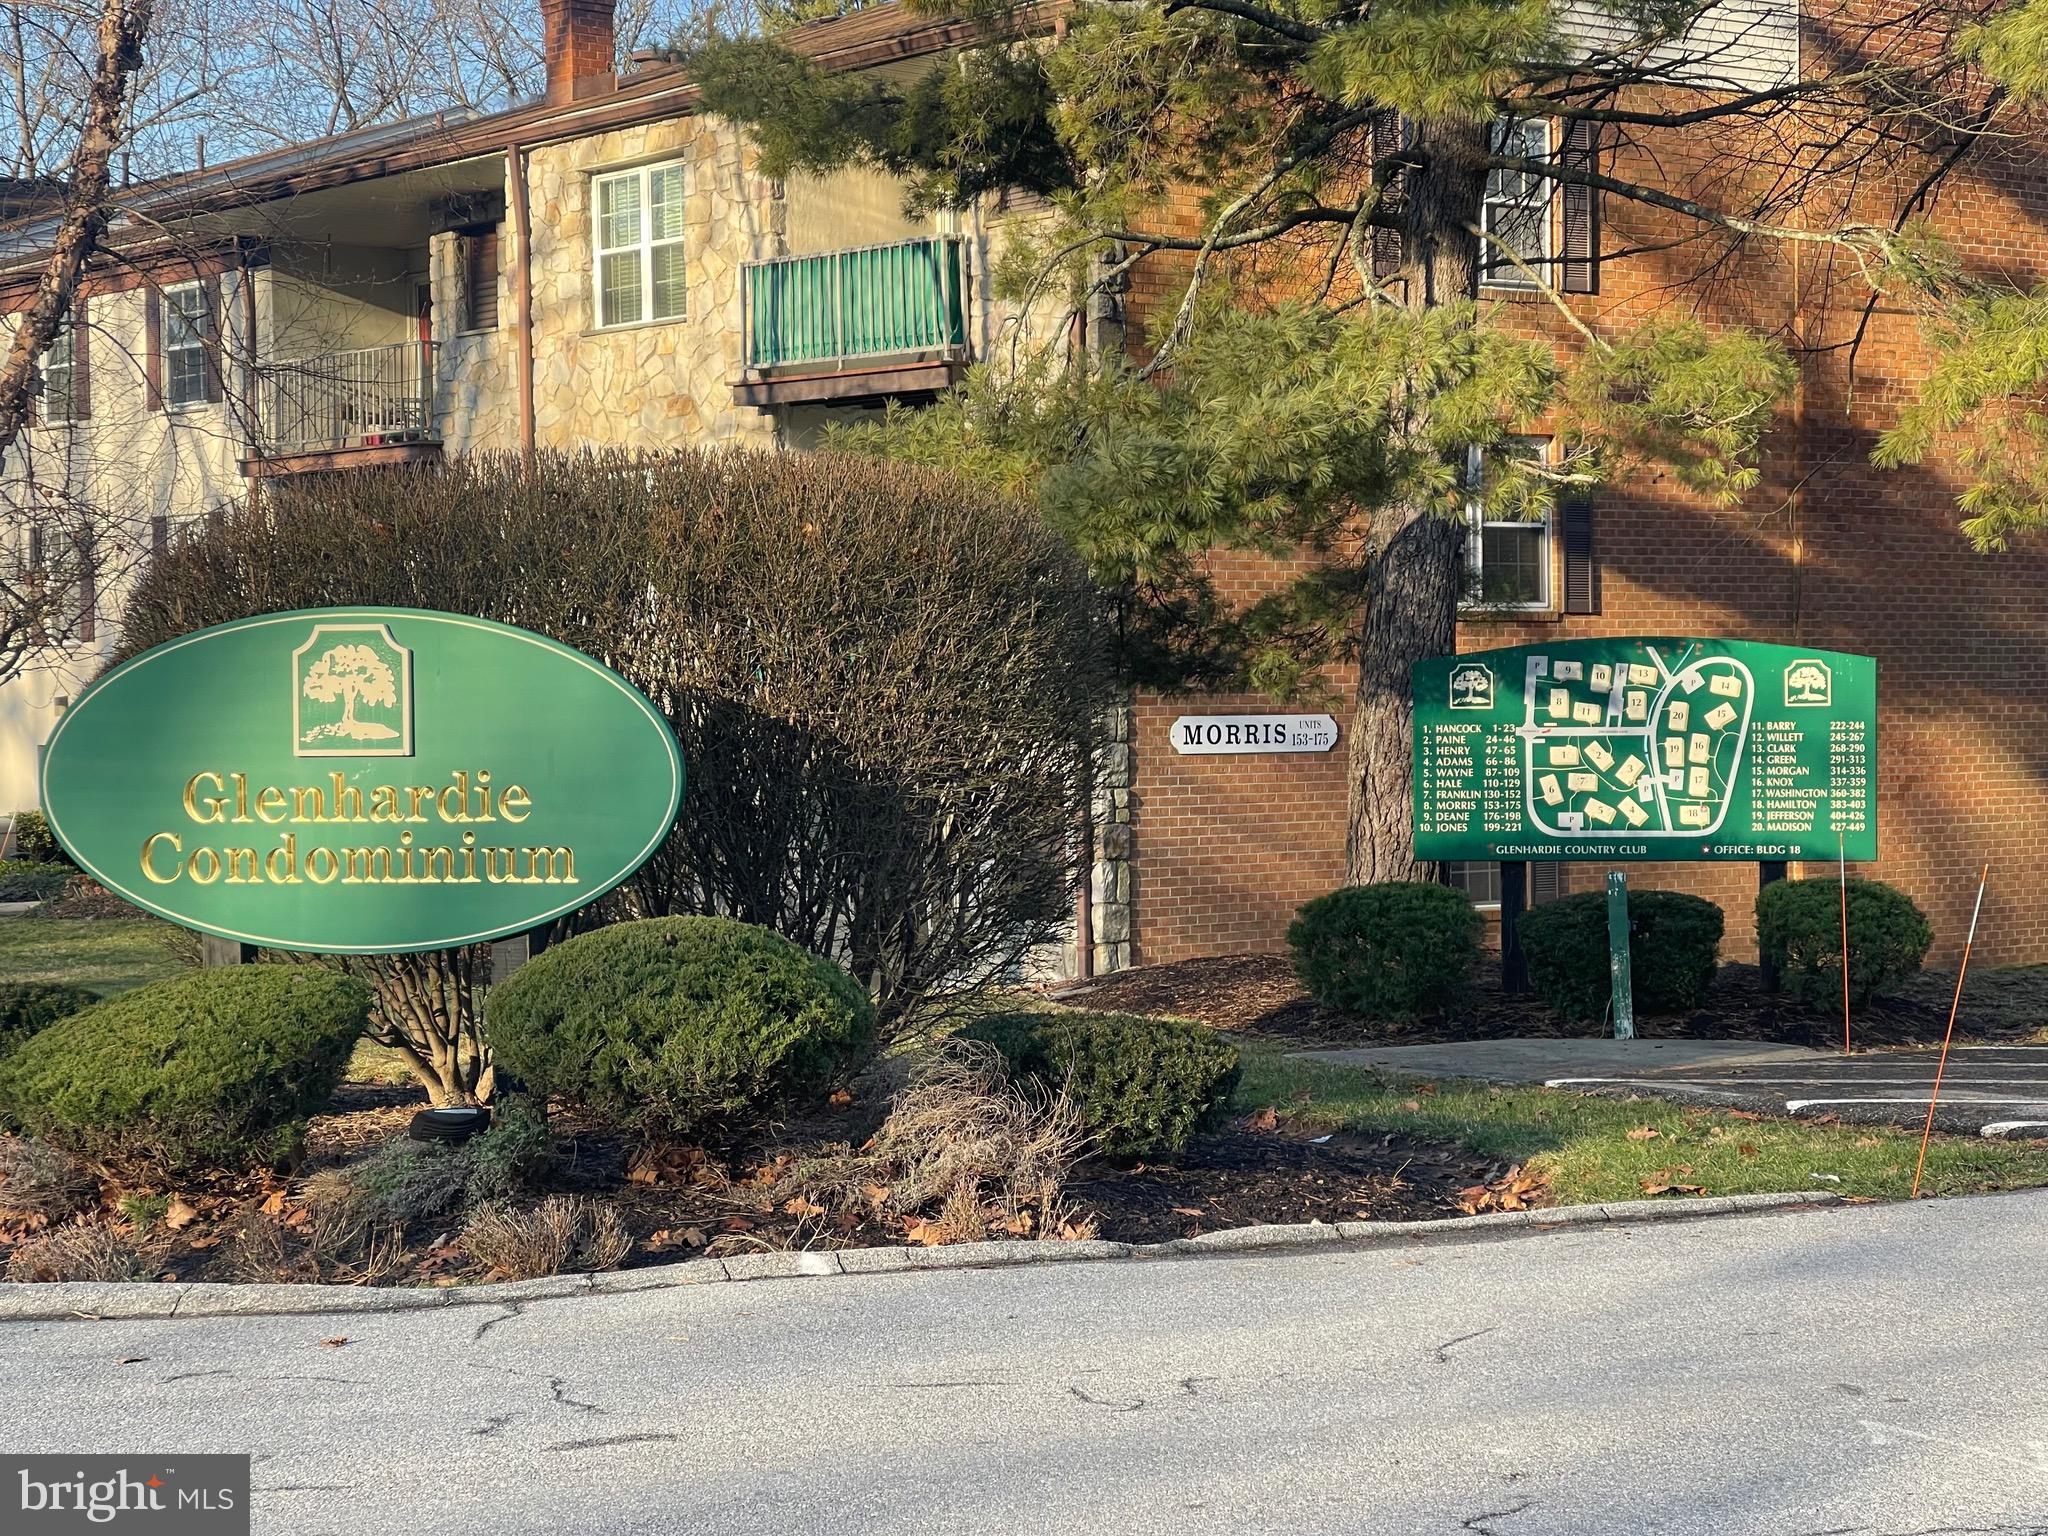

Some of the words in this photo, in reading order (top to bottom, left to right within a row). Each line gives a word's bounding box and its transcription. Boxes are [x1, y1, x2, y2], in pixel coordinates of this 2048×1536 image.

[1565, 665, 1571, 674] 9
[1595, 672, 1606, 680] 10
[1721, 682, 1730, 690] 14
[1672, 711, 1684, 720] 20
[1717, 710, 1726, 718] 15
[1299, 720, 1322, 729] UNITS
[1423, 725, 1432, 734] 1.
[1435, 724, 1482, 733] HANCOCK
[1752, 722, 1765, 731] 11.
[1766, 722, 1796, 731] BARRY
[1830, 721, 1865, 730] 222-244
[1183, 723, 1286, 745] MORRIS
[1752, 733, 1765, 742] 12.
[1766, 733, 1804, 742] WILLETT
[1830, 732, 1865, 741] 245-267
[1292, 733, 1329, 746] 153-175
[1423, 736, 1432, 745] 2.
[1436, 735, 1466, 744] PAINE
[1695, 742, 1704, 750] 16
[1752, 744, 1765, 753] 13.
[1766, 744, 1796, 753] CLARK
[1830, 744, 1866, 753] 268-290
[1423, 747, 1433, 756] 3.
[1436, 746, 1471, 755] HENRY
[1423, 758, 1433, 766] 4.
[1436, 757, 1473, 766] ADAMS
[1752, 755, 1765, 764] 14.
[1766, 755, 1797, 764] GREEN
[1830, 755, 1866, 764] 291-313
[1423, 769, 1433, 777] 5.
[1436, 768, 1474, 777] WAYNE
[1752, 766, 1765, 775] 15.
[1766, 766, 1810, 775] MORGAN
[1830, 766, 1866, 775] 314-336
[1423, 780, 1433, 788] 6.
[1436, 779, 1462, 788] HALE
[1694, 775, 1704, 784] 17
[1752, 778, 1765, 787] 16.
[1766, 778, 1794, 787] KNOX
[1830, 777, 1866, 786] 337-359
[1549, 785, 1555, 793] 6
[1752, 789, 1765, 798] 17.
[1766, 789, 1828, 798] WASHINGTON
[1830, 789, 1866, 798] 360-382
[183, 769, 532, 824] Glenhardie
[1423, 791, 1432, 799] 7.
[1436, 790, 1482, 799] FRANKLIN
[1423, 802, 1433, 810] 8.
[1436, 801, 1477, 810] MORRIS
[1752, 800, 1765, 809] 18.
[1766, 800, 1817, 809] HAMILTON
[1830, 800, 1866, 809] 383-403
[1423, 812, 1433, 821] 9.
[1436, 812, 1470, 821] DEANE
[1752, 811, 1765, 821] 19.
[1766, 811, 1814, 821] JEFFERSON
[1830, 811, 1865, 820] 404-426
[1419, 824, 1433, 832] 10.
[1436, 823, 1468, 834] JONES
[1752, 823, 1765, 832] 20.
[1766, 823, 1812, 832] MADISON
[1830, 822, 1866, 831] 427-449
[1495, 845, 1561, 854] GLENHARDIE
[1564, 845, 1616, 854] COUNTRY
[1619, 845, 1647, 854] CLUB
[1714, 845, 1754, 854] OFFICE:
[1756, 845, 1786, 854] BLDG
[1789, 845, 1801, 854] 18
[140, 830, 579, 883] Condominium
